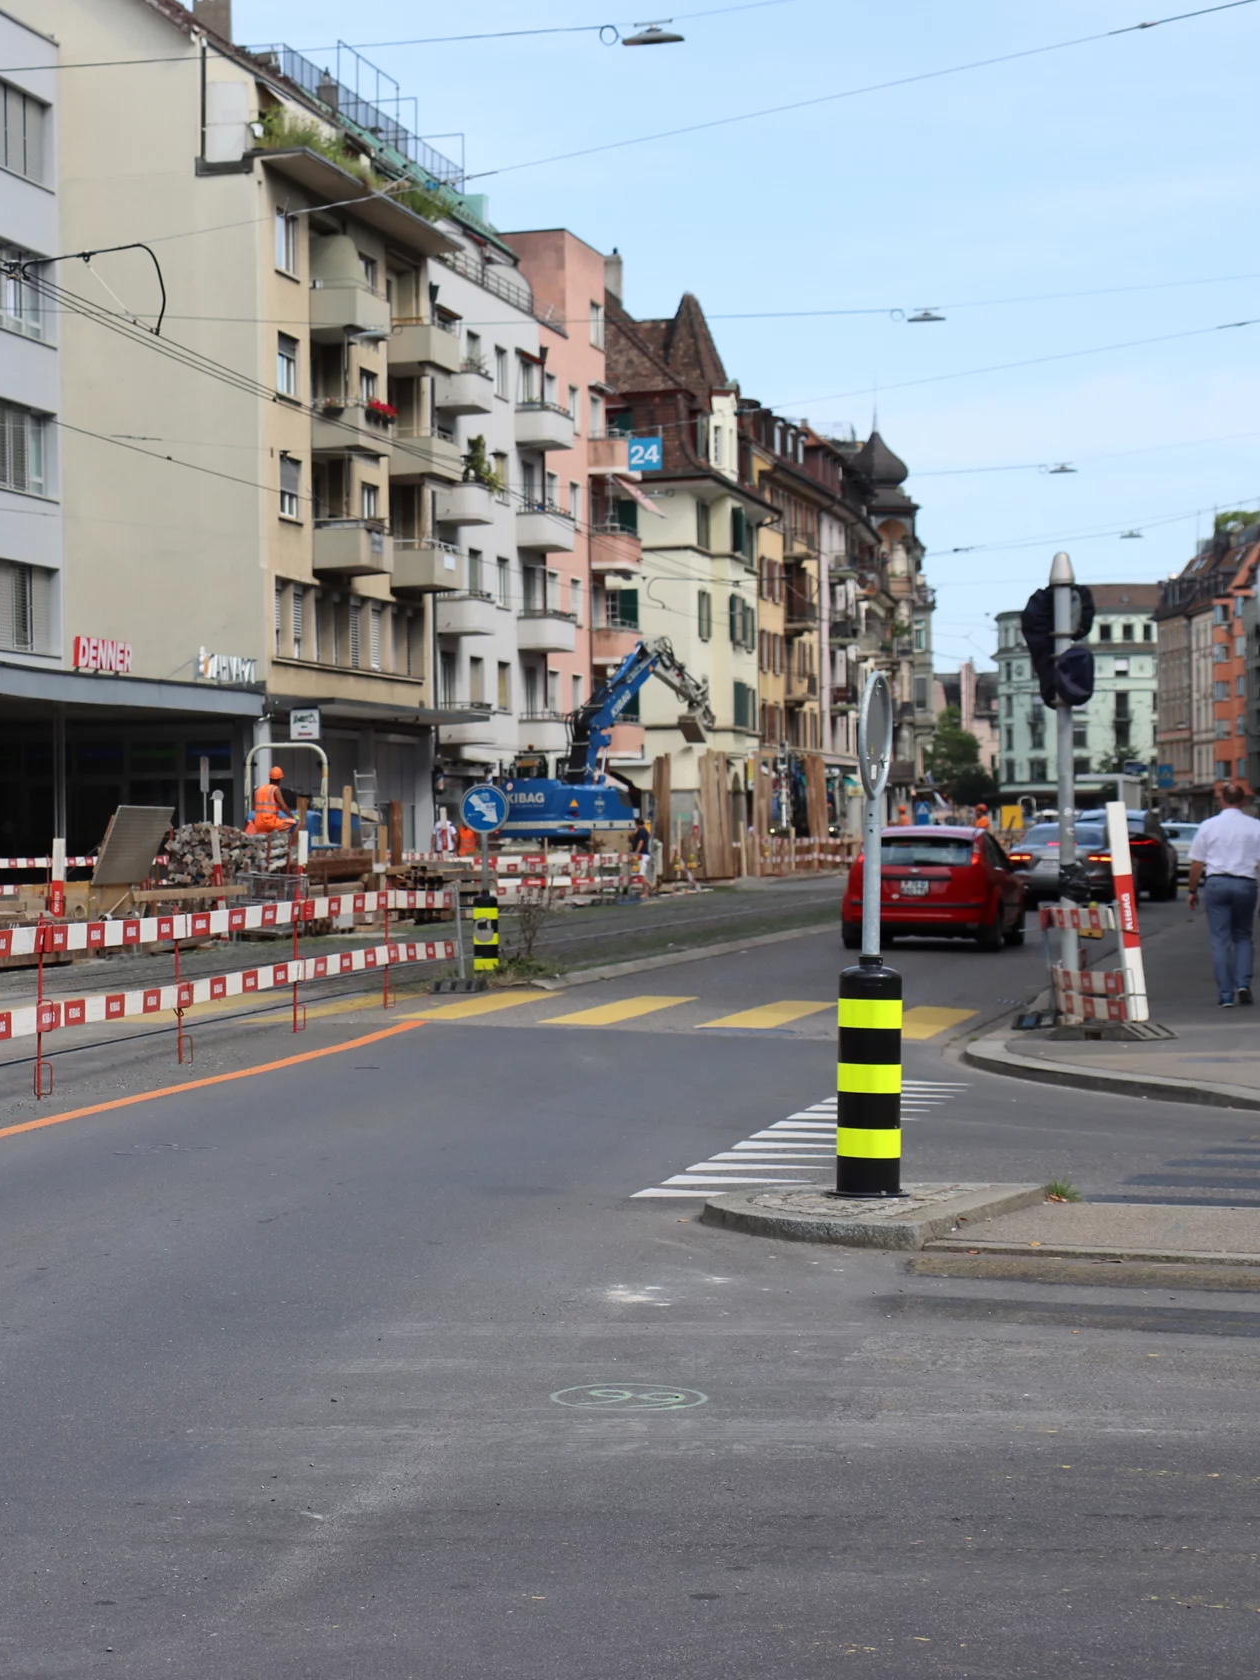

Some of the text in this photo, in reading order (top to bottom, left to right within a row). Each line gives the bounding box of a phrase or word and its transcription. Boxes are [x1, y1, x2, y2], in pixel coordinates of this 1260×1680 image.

[630, 444, 660, 465] 24
[76, 637, 132, 673] DENNER
[506, 792, 545, 804] KIBAG
